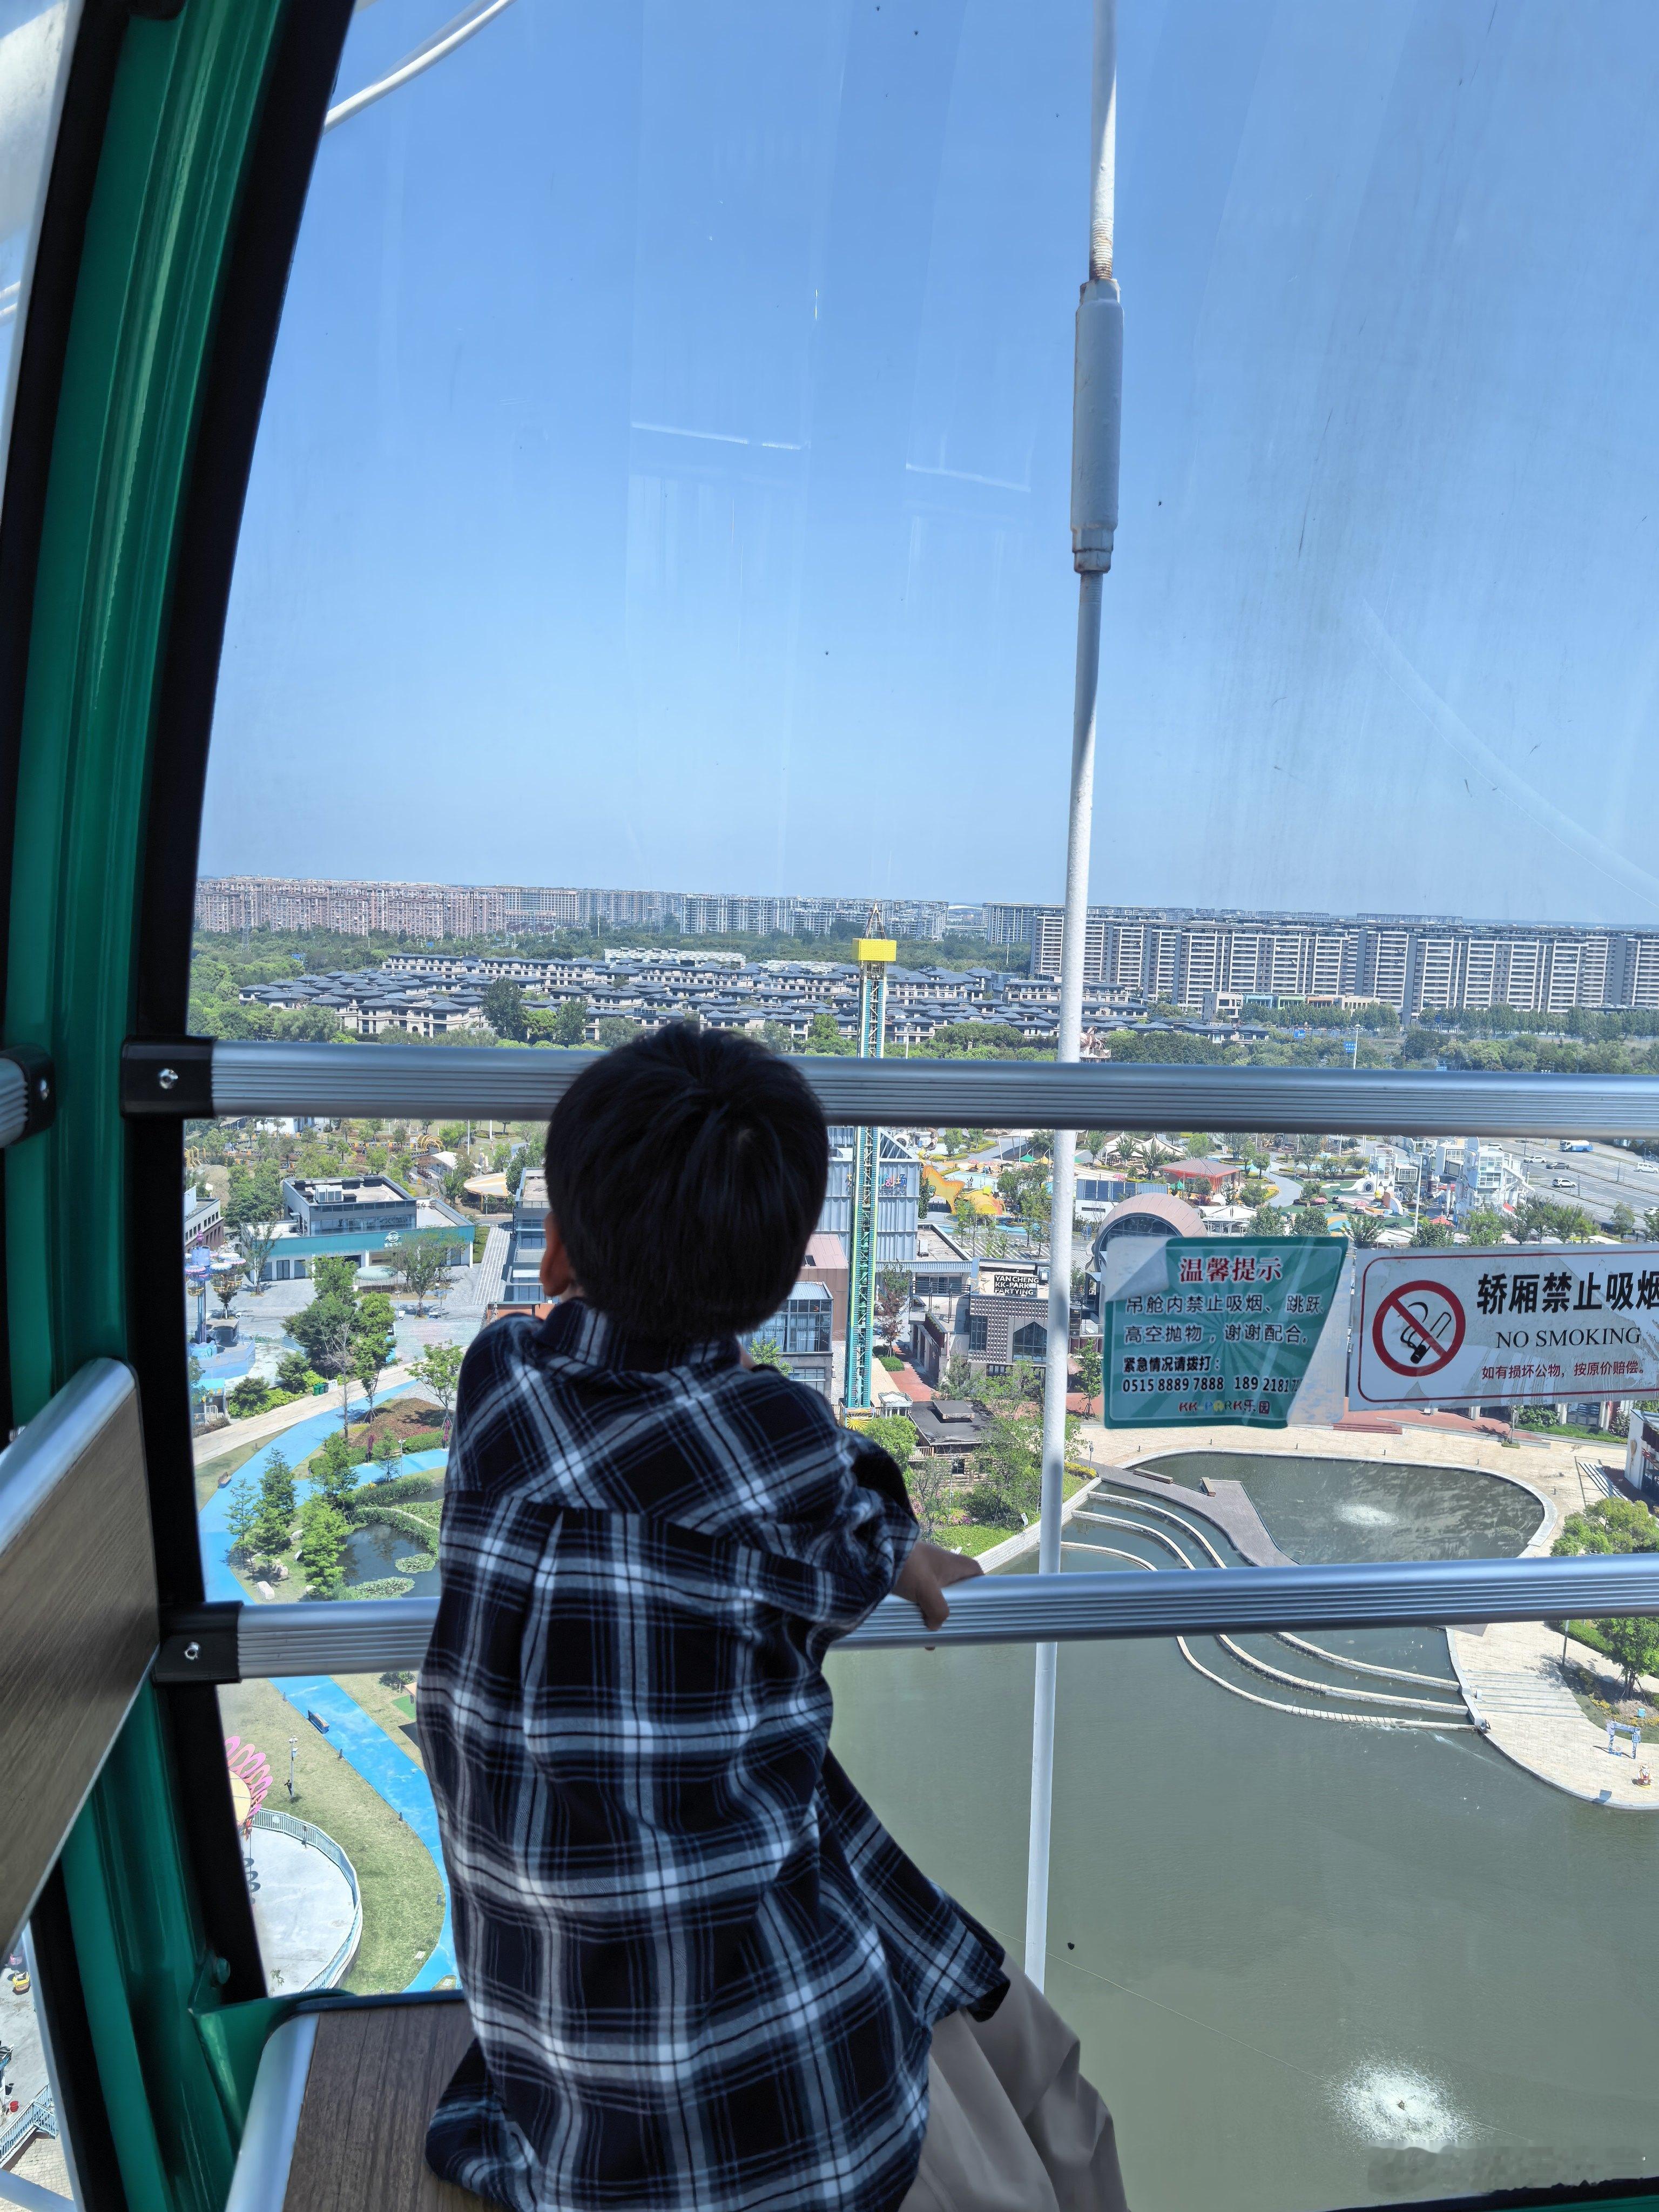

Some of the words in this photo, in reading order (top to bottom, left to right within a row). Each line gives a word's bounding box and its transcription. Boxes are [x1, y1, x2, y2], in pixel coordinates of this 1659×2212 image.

[1180, 1257, 1282, 1282] 温馨提示
[1476, 1270, 1659, 1314] 轿厢禁止吸烟
[1495, 1331, 1529, 1348] NO
[1535, 1326, 1642, 1347] SMOKING
[1123, 1378, 1154, 1392] 0515
[1158, 1378, 1189, 1391] 8889
[1193, 1377, 1224, 1391] 7888
[1235, 1377, 1258, 1390] 189
